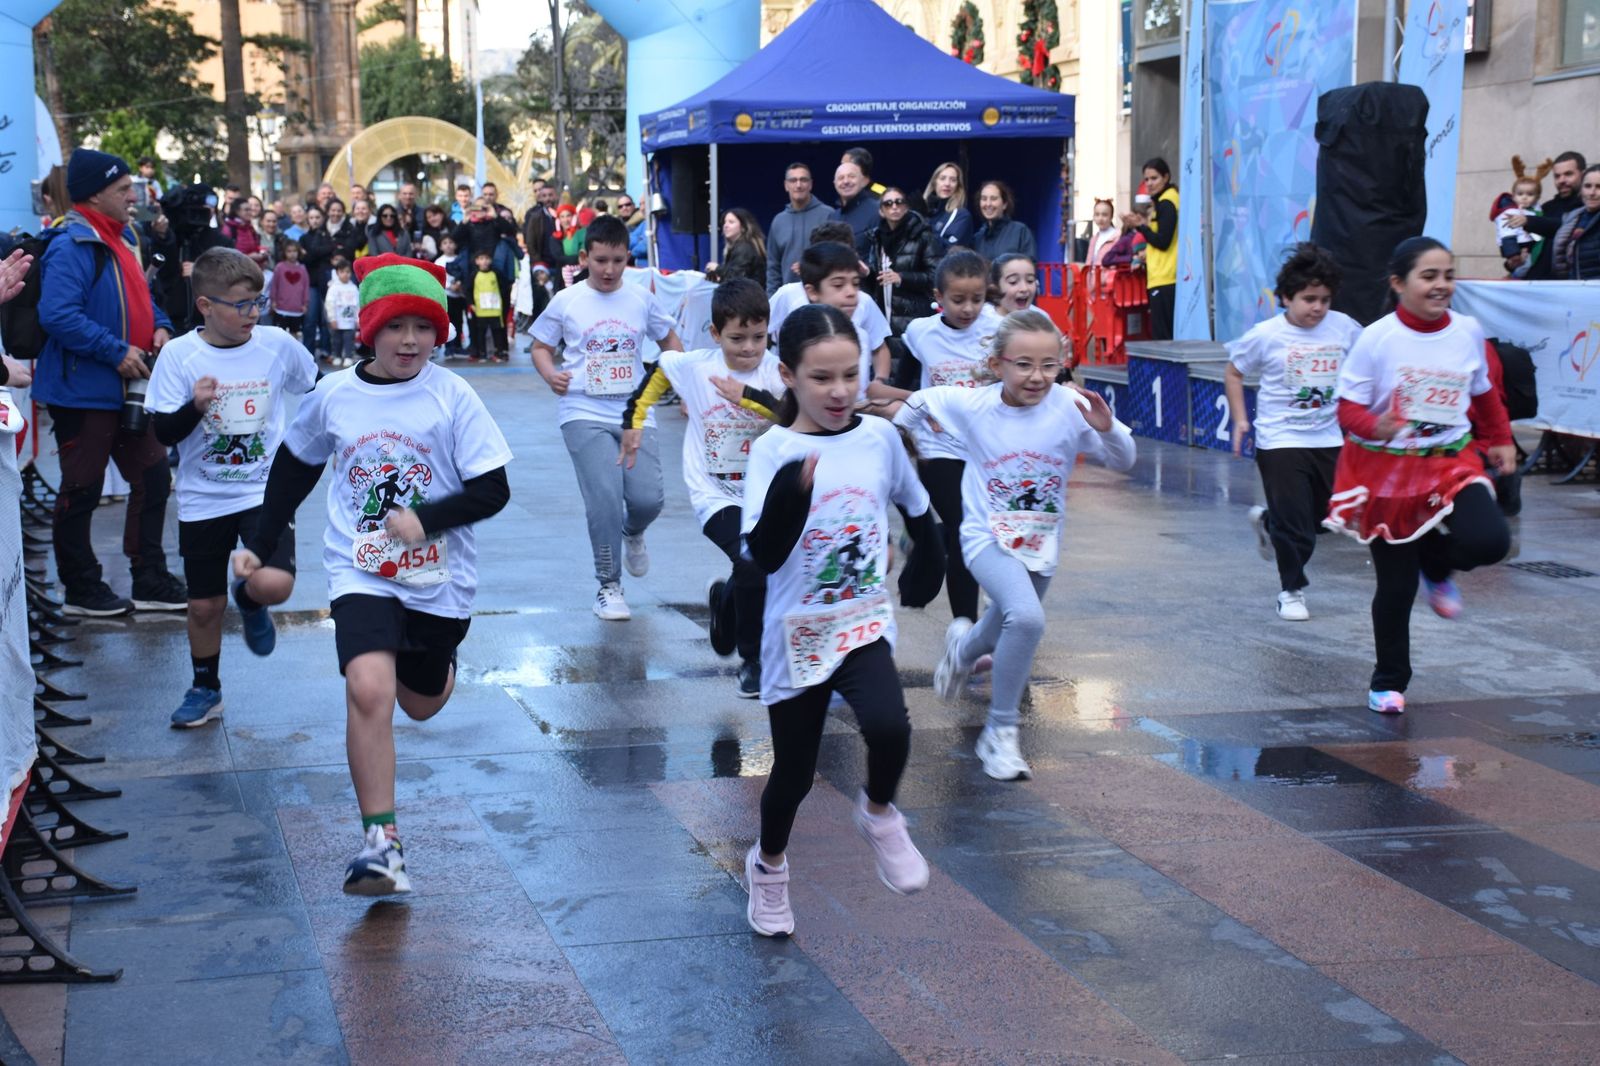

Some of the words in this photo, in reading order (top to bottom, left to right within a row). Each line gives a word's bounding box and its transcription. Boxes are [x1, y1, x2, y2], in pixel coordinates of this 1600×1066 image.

[825, 102, 897, 112] CRONOMETRAJE
[898, 100, 967, 110] ORGANIZACIÓN
[893, 113, 900, 122] Y
[821, 124, 861, 134] GESTIÓN
[861, 124, 874, 134] DE
[875, 123, 915, 133] EVENTOS
[915, 123, 972, 133] DEPORTIVOS
[609, 365, 633, 381] 303
[1311, 359, 1338, 373] 214
[1152, 375, 1163, 429] 1
[1424, 387, 1461, 407] 292
[244, 399, 256, 416] 6
[1215, 394, 1231, 442] 2
[380, 428, 403, 442] Ciudad
[397, 543, 440, 570] 454
